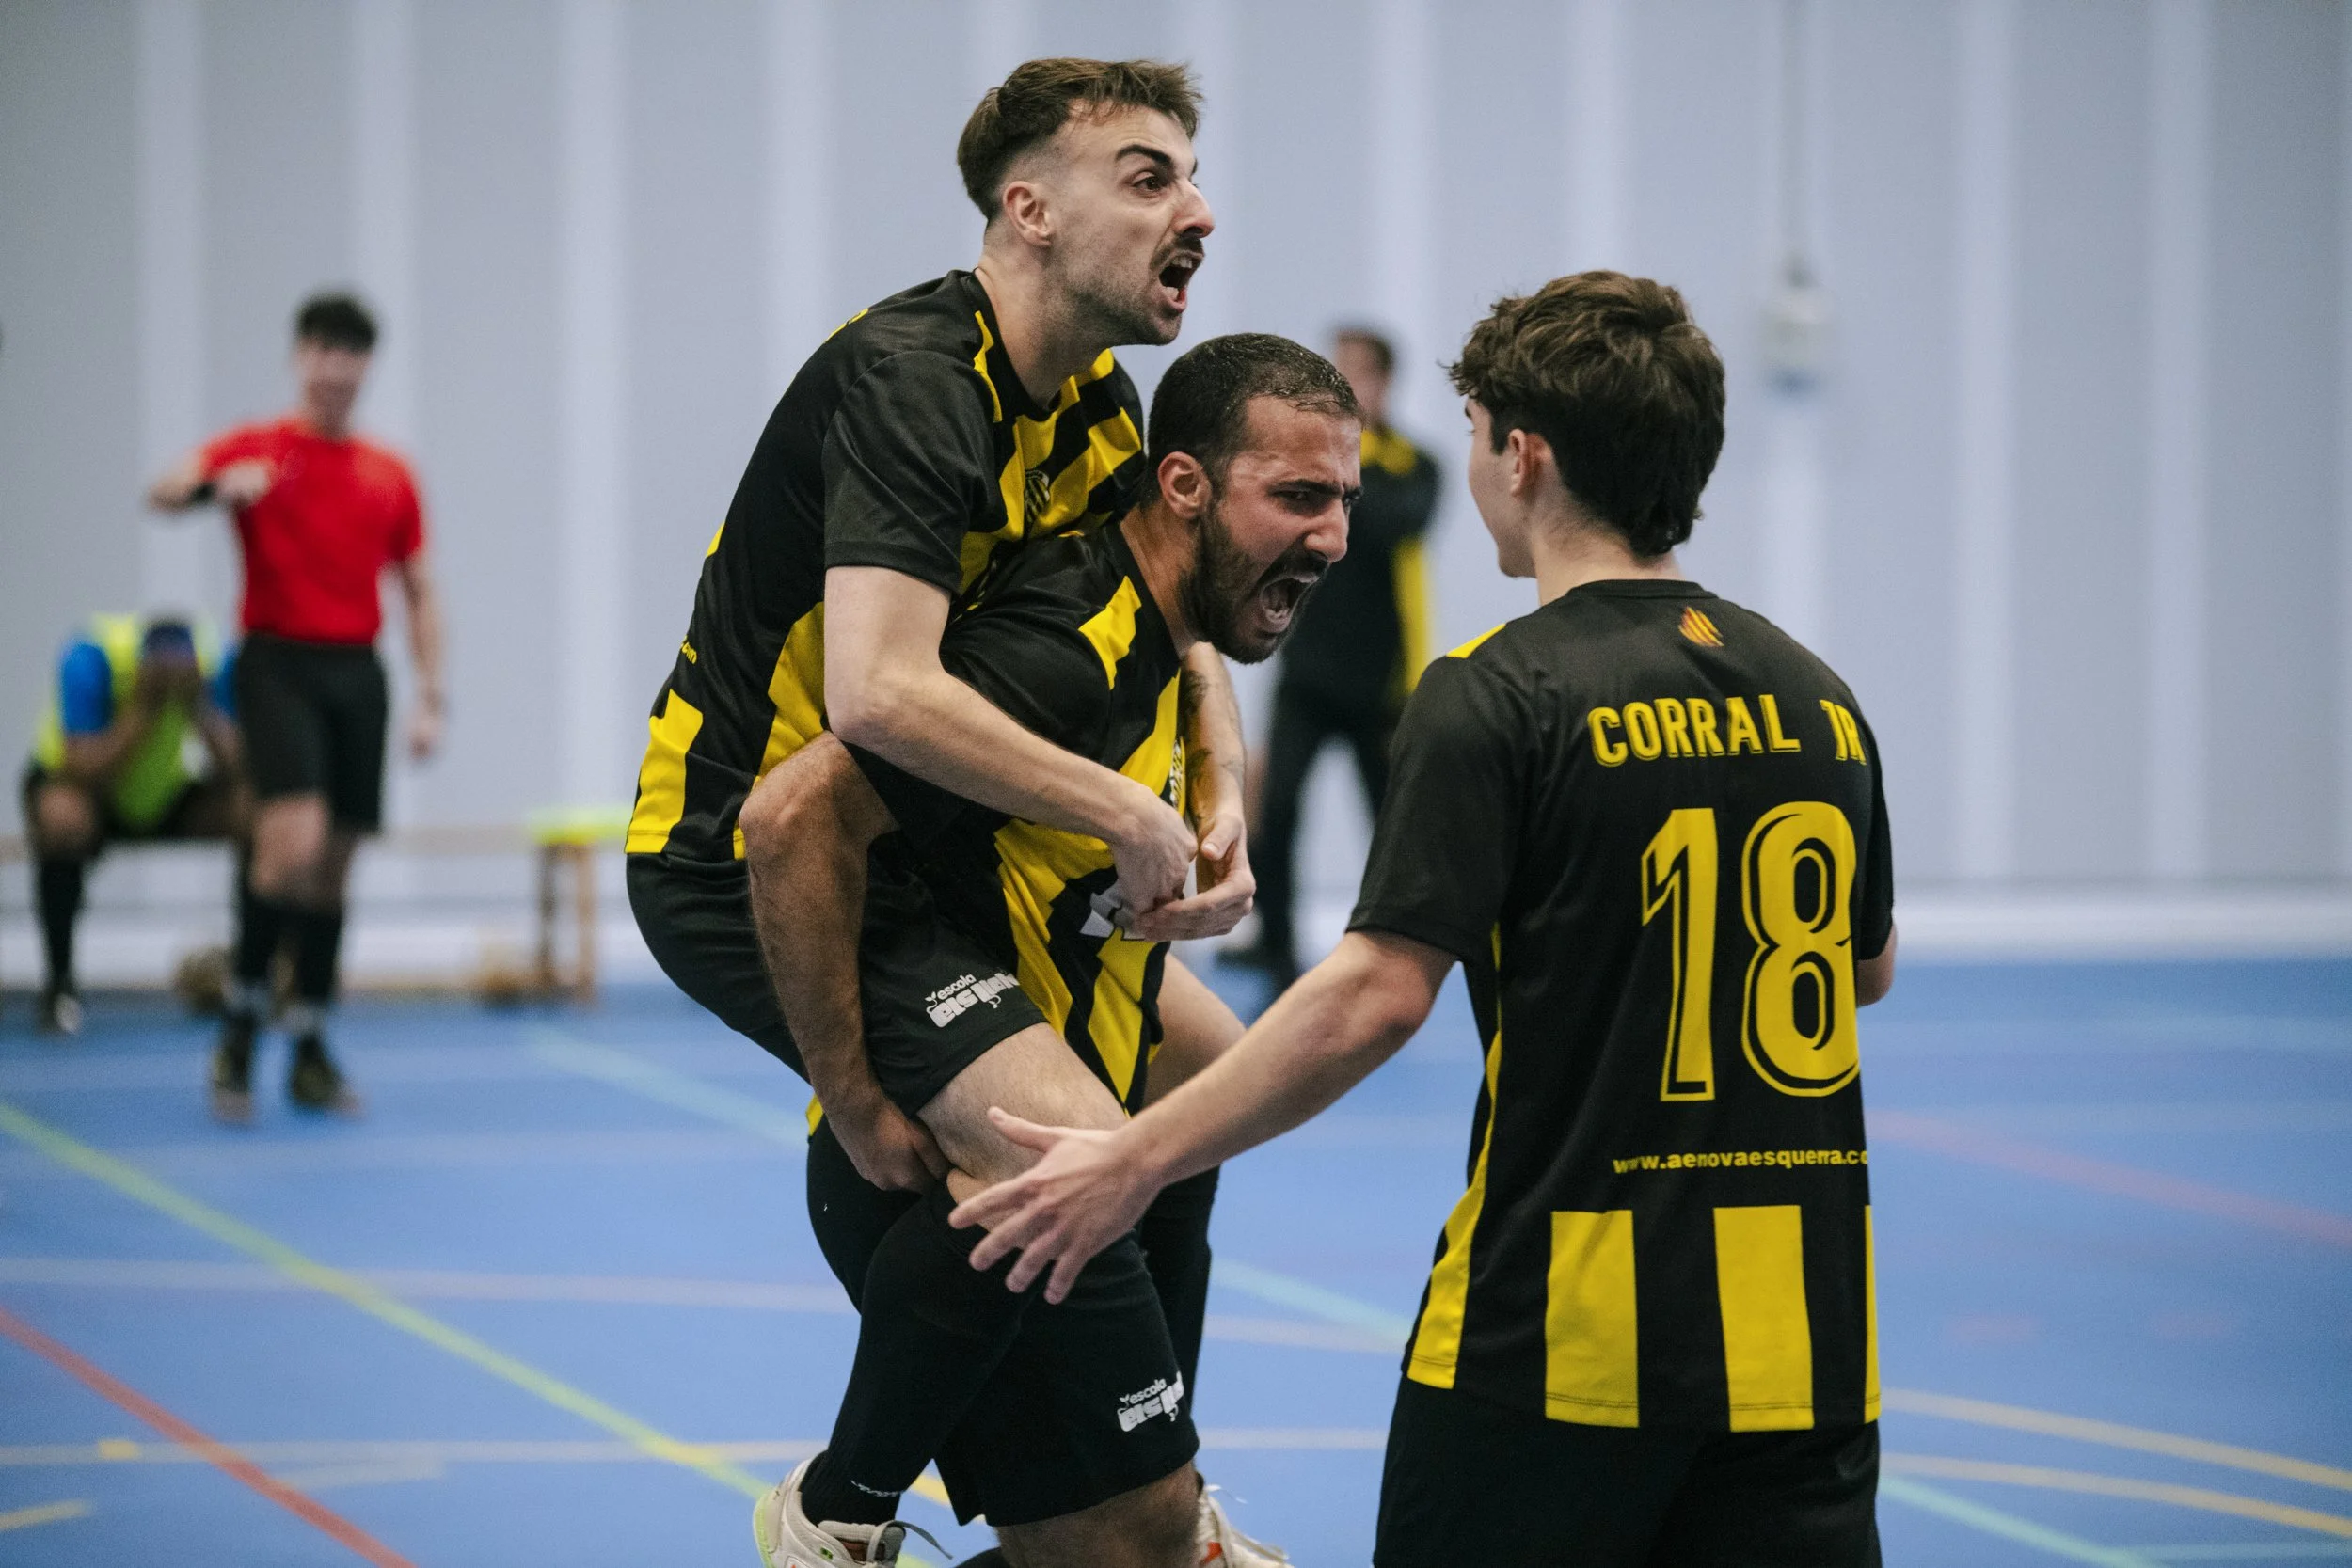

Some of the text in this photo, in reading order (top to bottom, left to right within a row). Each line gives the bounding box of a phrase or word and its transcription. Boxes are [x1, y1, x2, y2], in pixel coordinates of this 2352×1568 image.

[1587, 694, 1801, 768] CORRAL
[1641, 800, 1860, 1102] 18
[937, 974, 977, 1000] escola
[1130, 1378, 1167, 1404] escola
